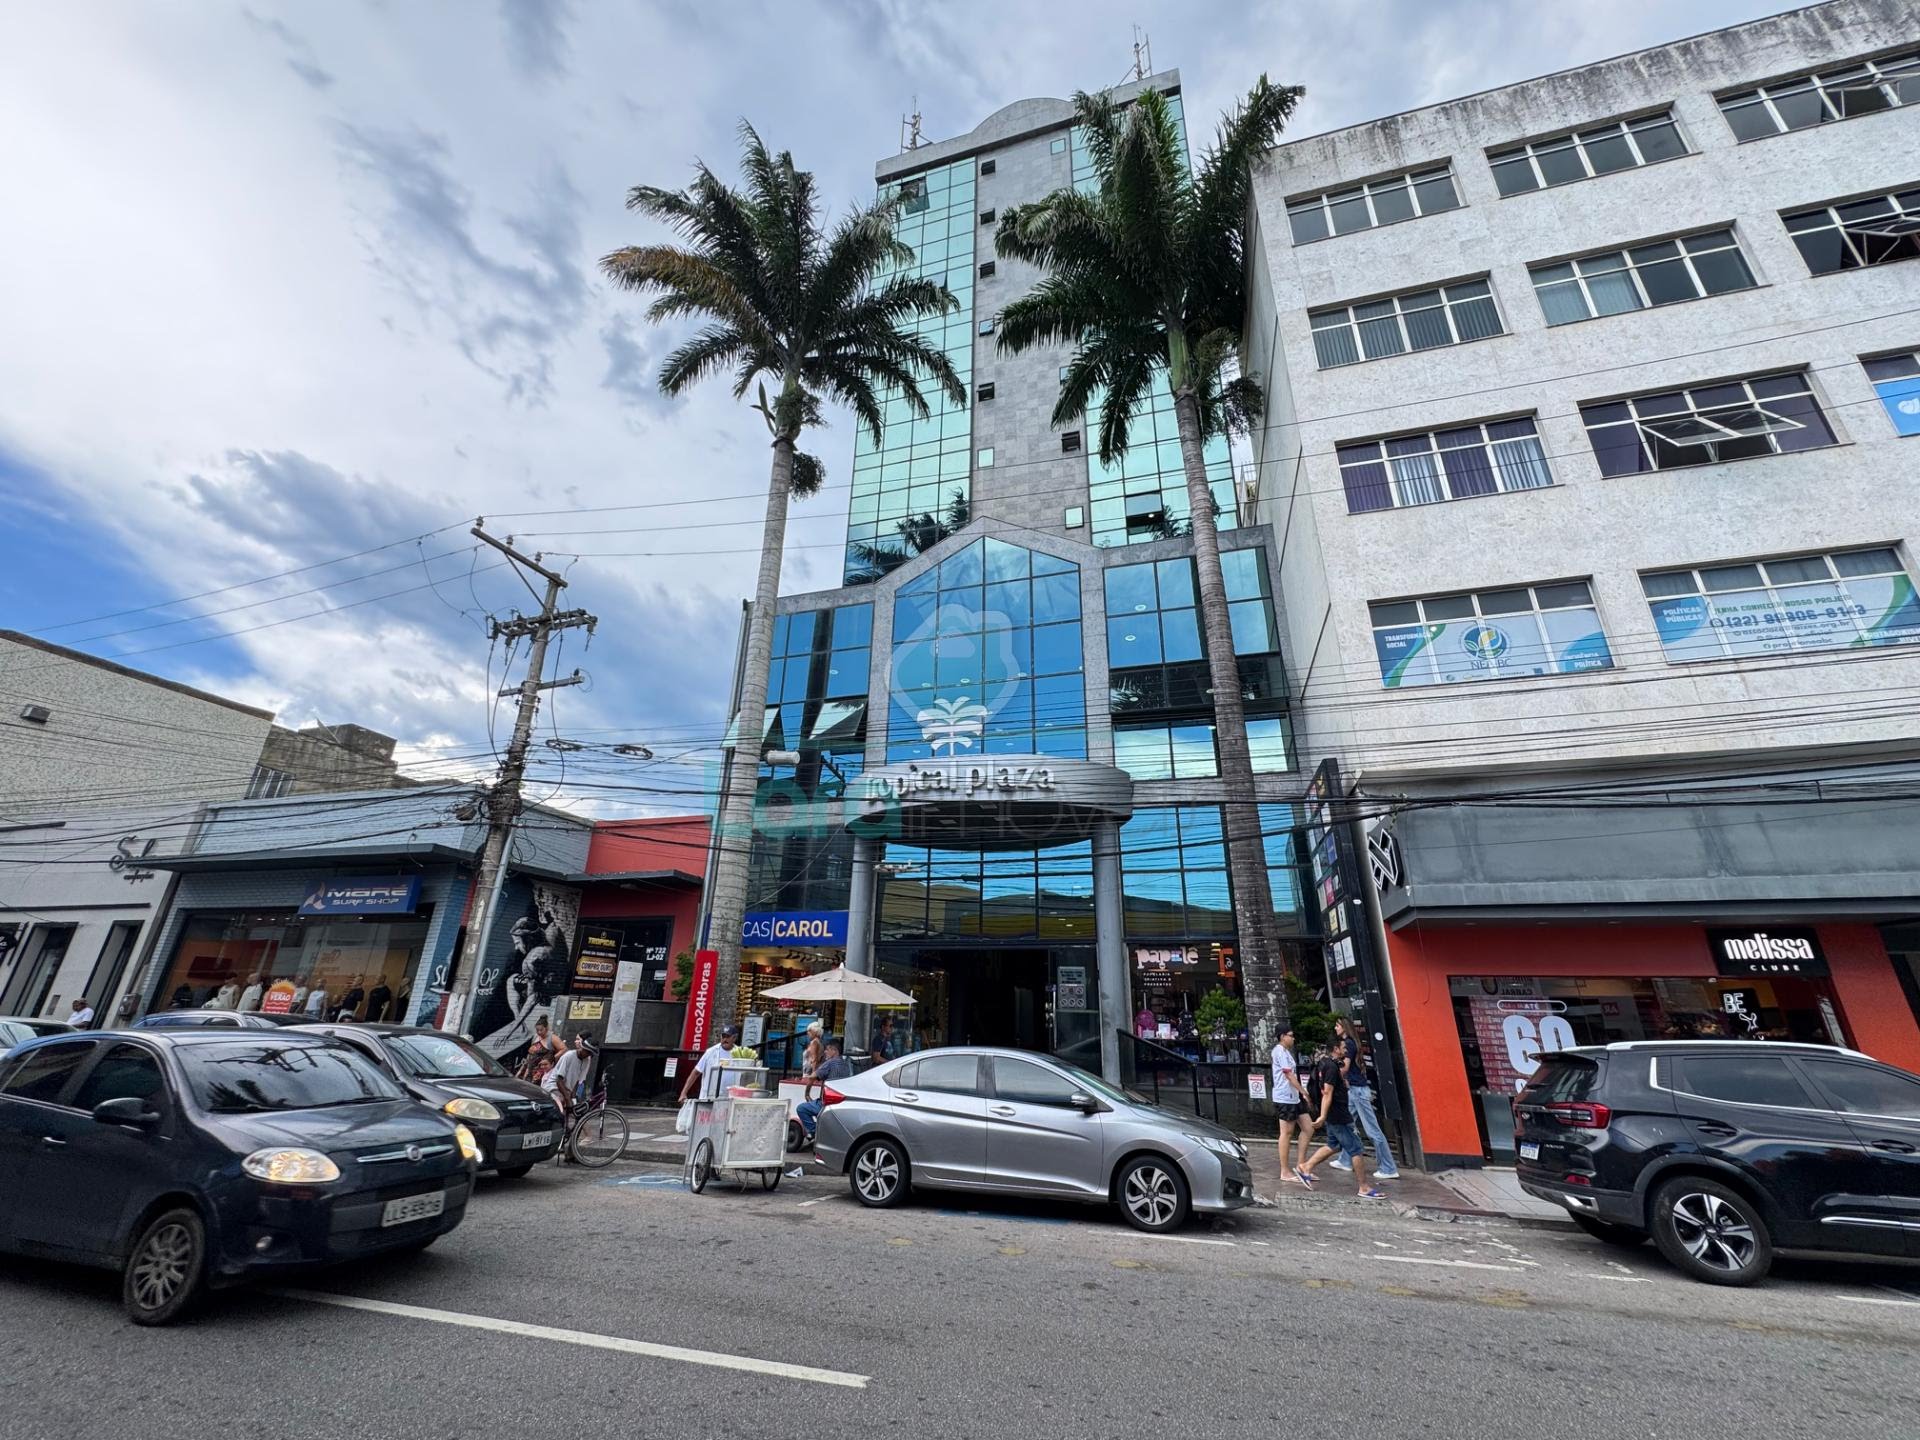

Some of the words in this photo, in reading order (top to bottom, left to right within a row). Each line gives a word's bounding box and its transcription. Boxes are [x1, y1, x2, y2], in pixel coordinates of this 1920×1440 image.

[1815, 594, 1853, 604] PROJE
[1384, 632, 1434, 642] TRANSFORMA
[1386, 641, 1407, 649] SOCIAL
[964, 758, 1056, 797] plaza
[332, 898, 363, 906] SURF
[775, 919, 834, 938] CAROL
[1724, 932, 1815, 960] melissa
[1749, 964, 1800, 972] CLUBE
[1723, 992, 1747, 1014] BE
[1502, 1014, 1577, 1076] 60
